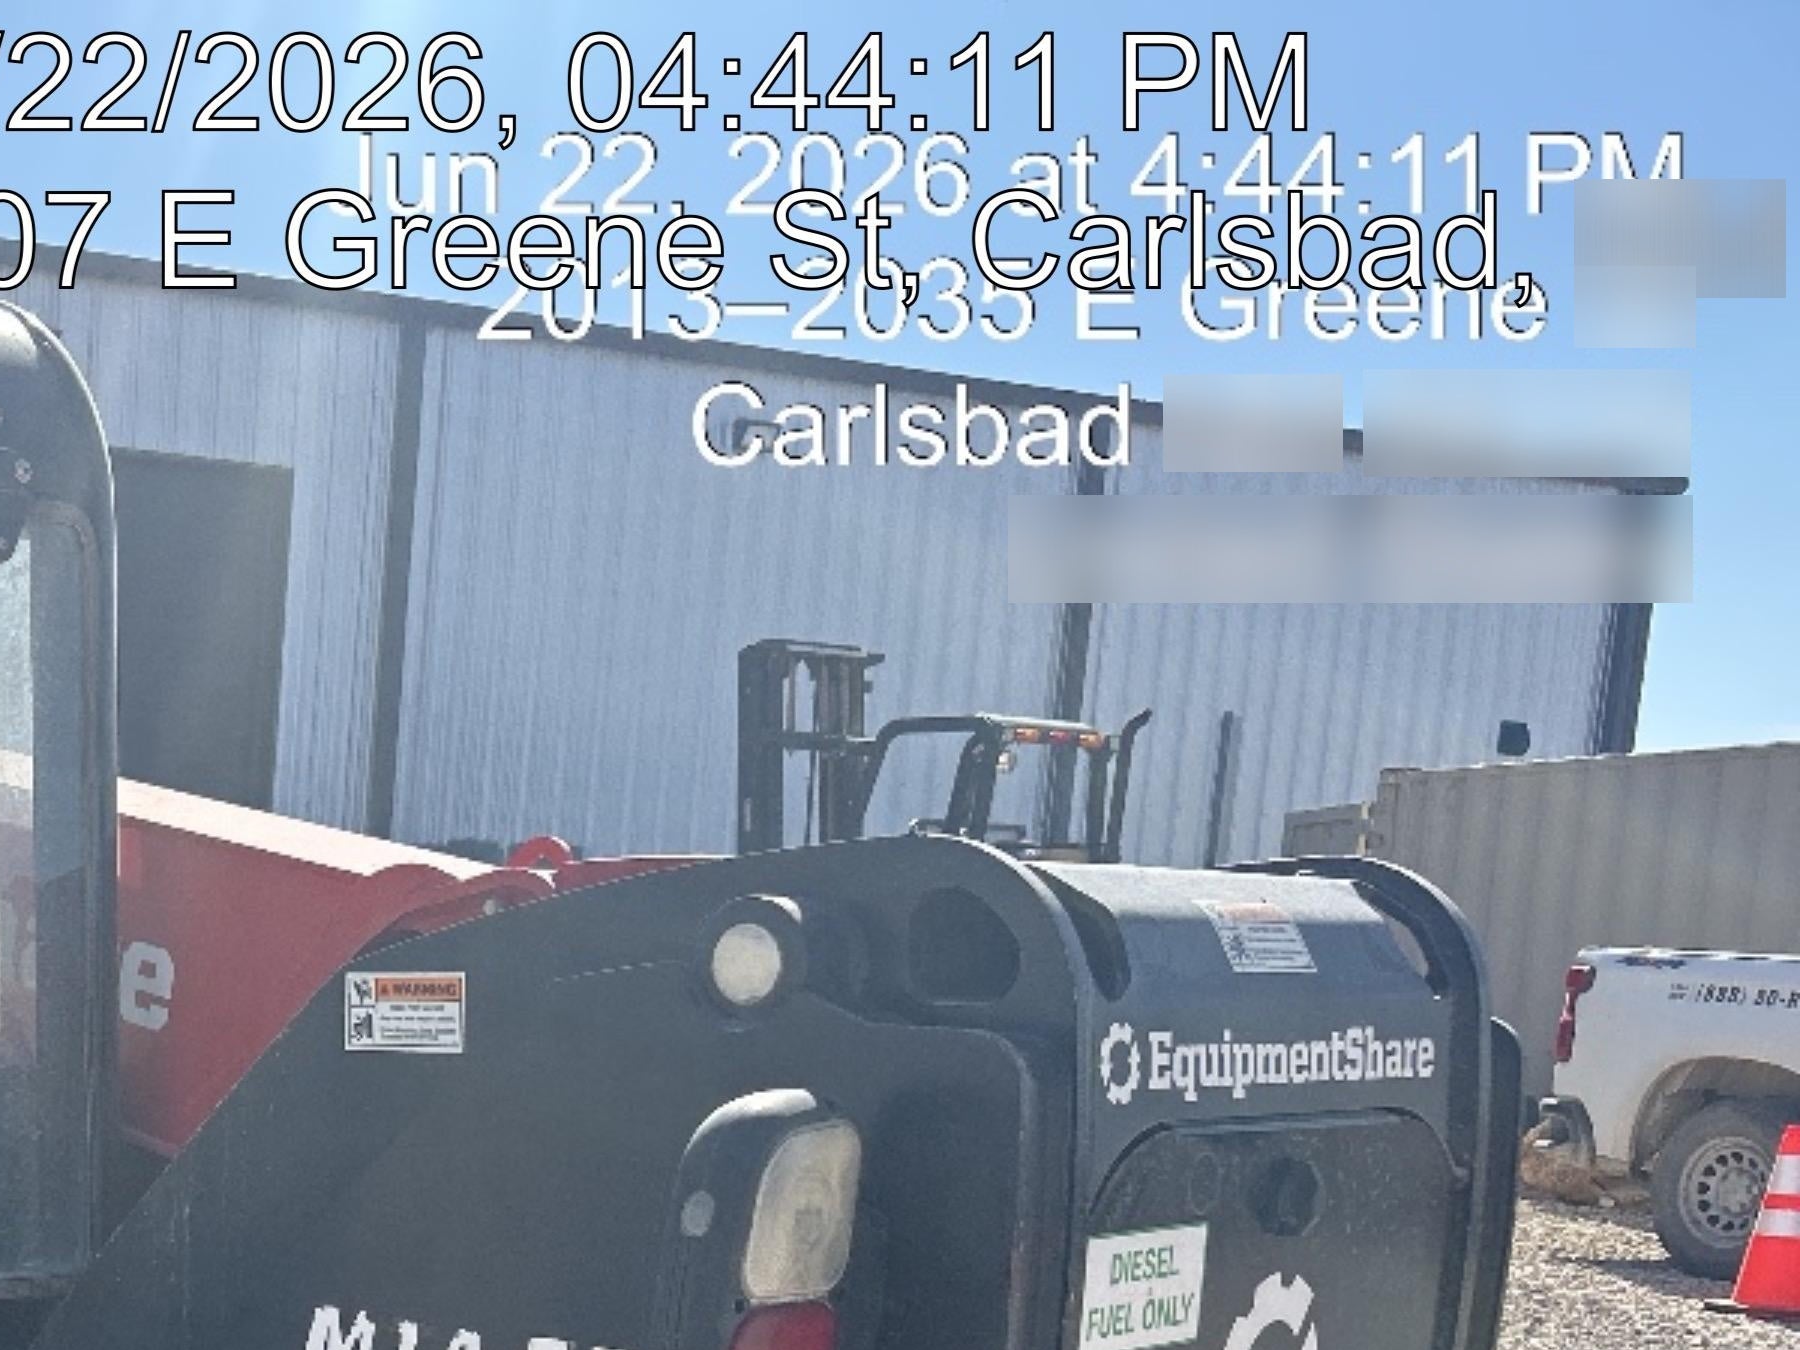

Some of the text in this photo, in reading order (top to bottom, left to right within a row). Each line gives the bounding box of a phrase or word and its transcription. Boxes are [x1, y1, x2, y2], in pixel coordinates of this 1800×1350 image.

[1148, 1026, 1435, 1101] EquipmentShare
[1109, 1244, 1180, 1285] DIESEL
[1084, 1293, 1195, 1342] FUEL ONLY
